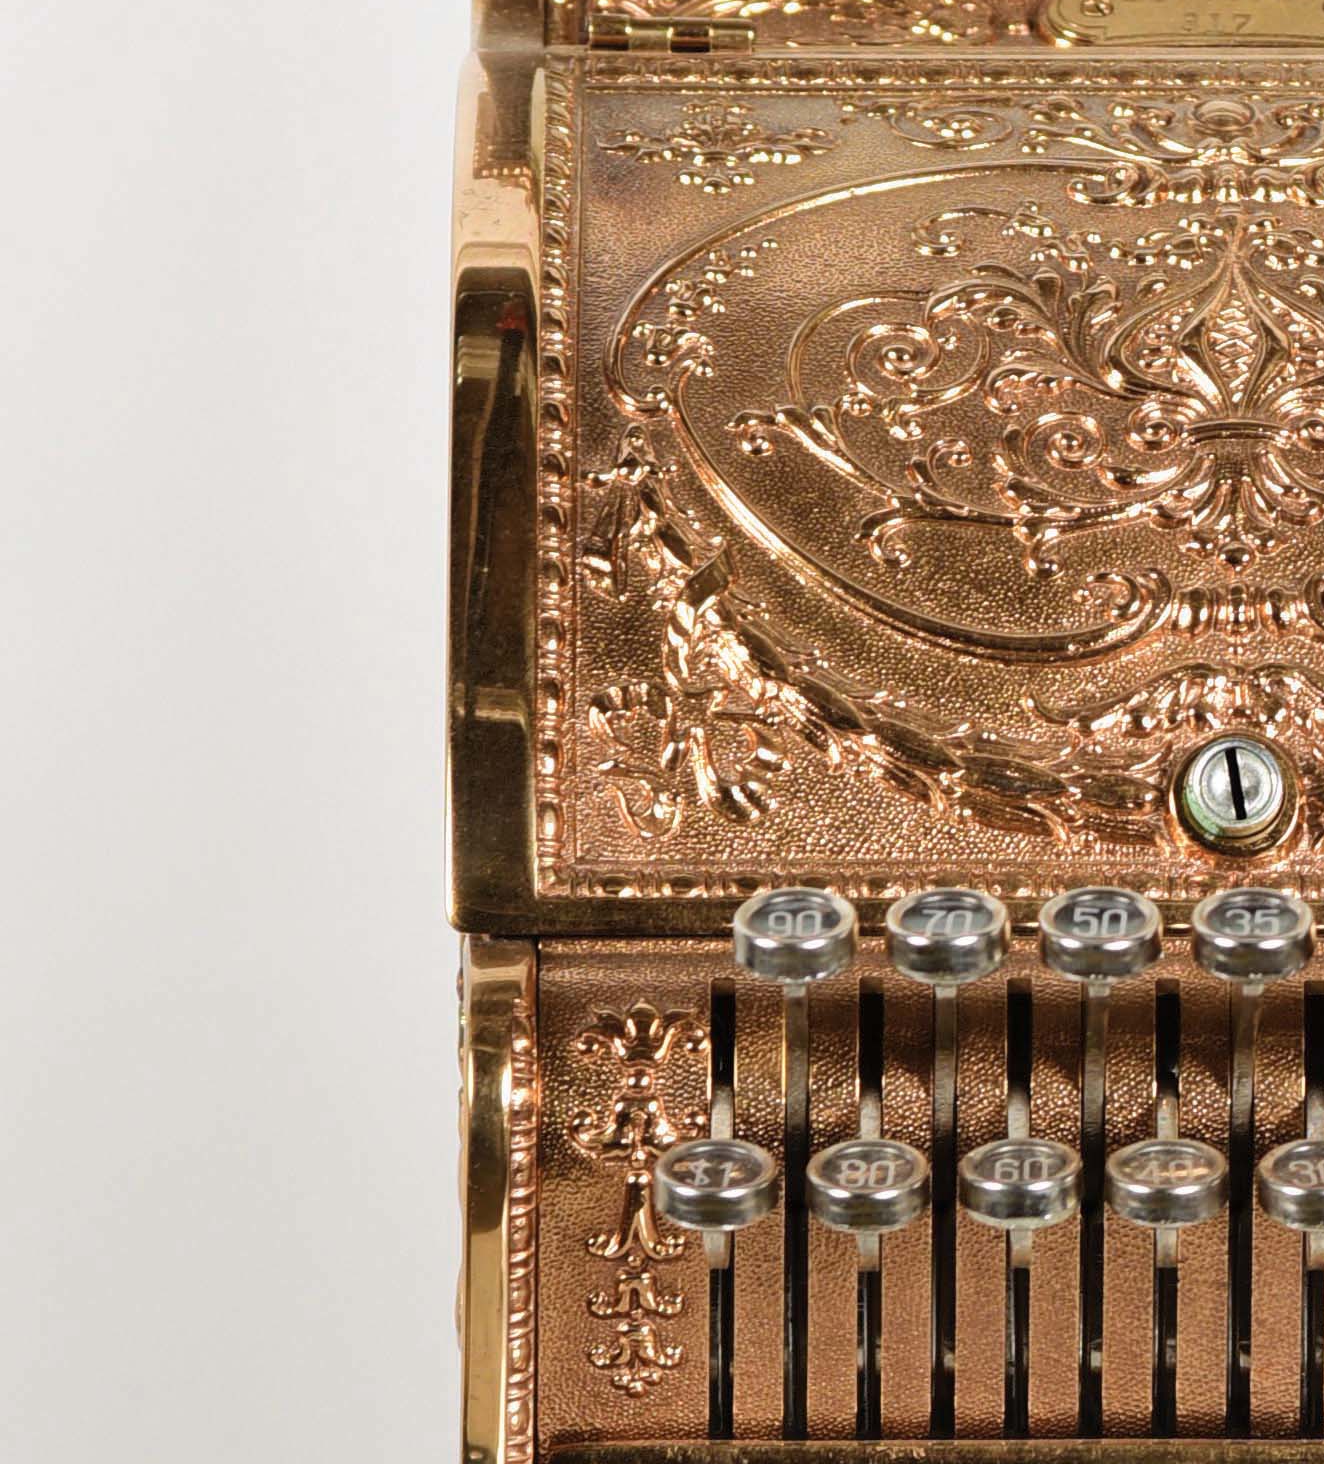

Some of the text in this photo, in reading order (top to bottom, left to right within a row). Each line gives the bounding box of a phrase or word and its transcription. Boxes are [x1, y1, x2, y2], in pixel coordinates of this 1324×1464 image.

[768, 910, 823, 936] 90
[921, 909, 974, 935] 70
[1072, 907, 1128, 936] 50
[1225, 908, 1281, 936] 35
[836, 1159, 896, 1189] 80
[993, 1157, 1050, 1181] 60
